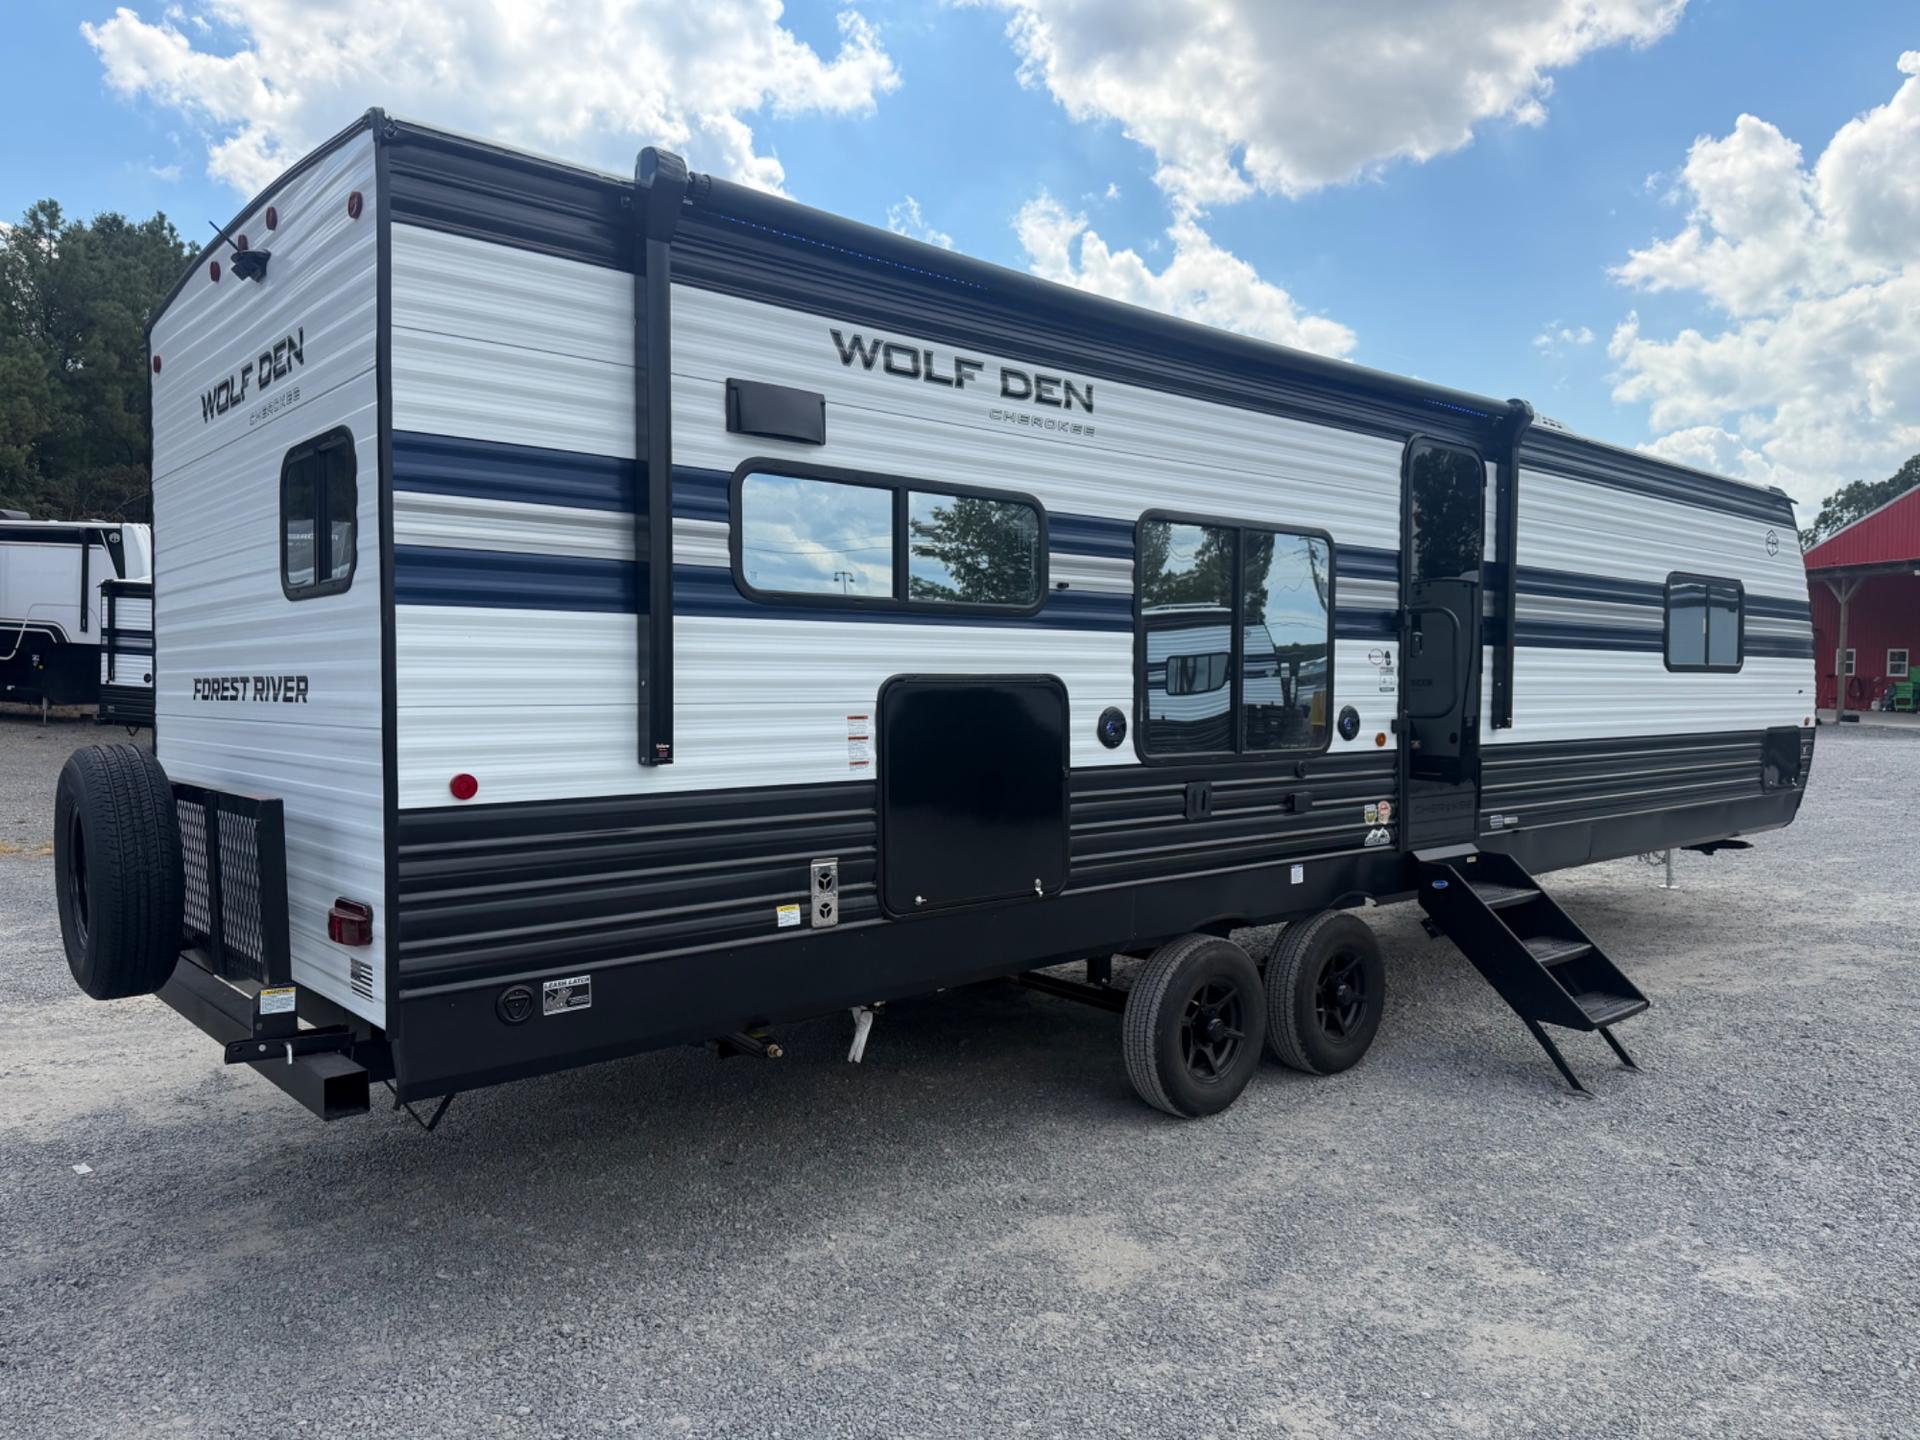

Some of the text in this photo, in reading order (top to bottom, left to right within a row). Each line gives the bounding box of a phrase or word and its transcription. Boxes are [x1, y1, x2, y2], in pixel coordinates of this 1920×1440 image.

[201, 327, 304, 423] WOLF DEN
[830, 328, 1094, 414] WOLF DEN
[250, 387, 301, 424] CHEROKEE
[989, 408, 1095, 436] CHEROKEE
[193, 676, 308, 703] FOREST RIVER
